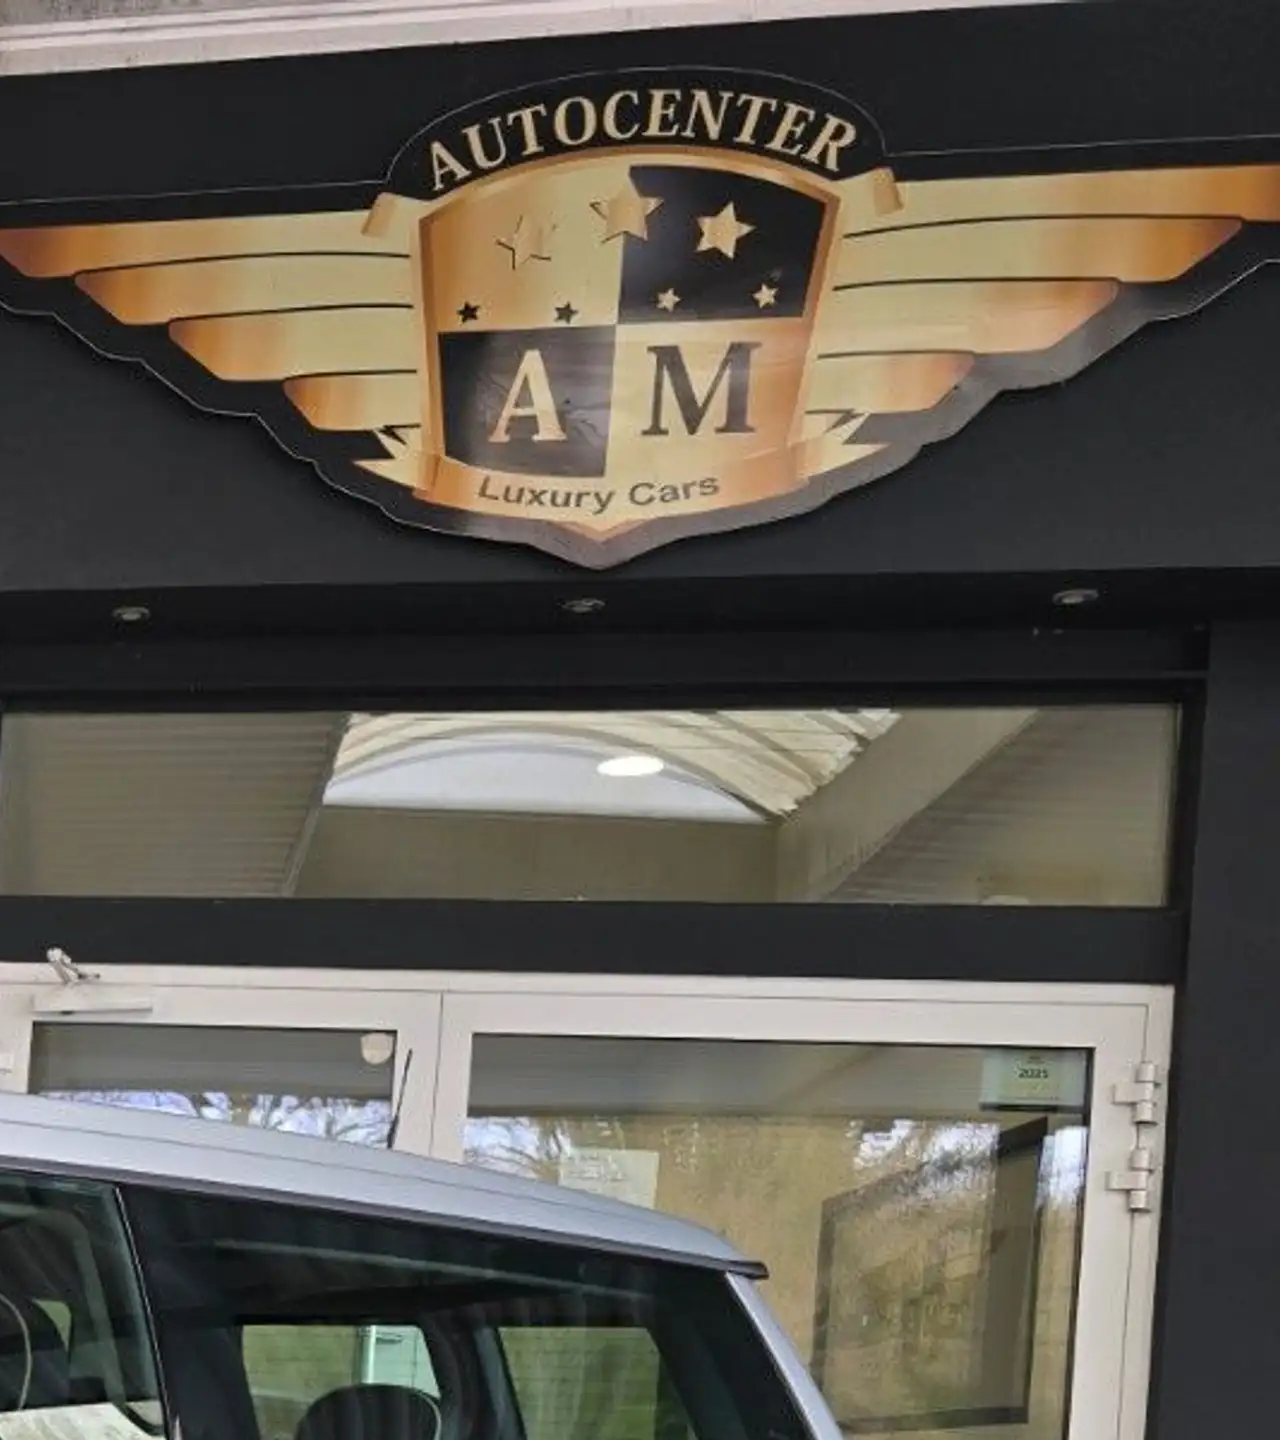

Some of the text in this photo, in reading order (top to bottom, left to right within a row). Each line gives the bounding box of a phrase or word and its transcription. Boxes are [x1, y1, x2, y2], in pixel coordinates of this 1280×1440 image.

[427, 88, 858, 192] AUTOCENTER
[487, 341, 763, 443] A M
[477, 475, 721, 516] Luxury Cars
